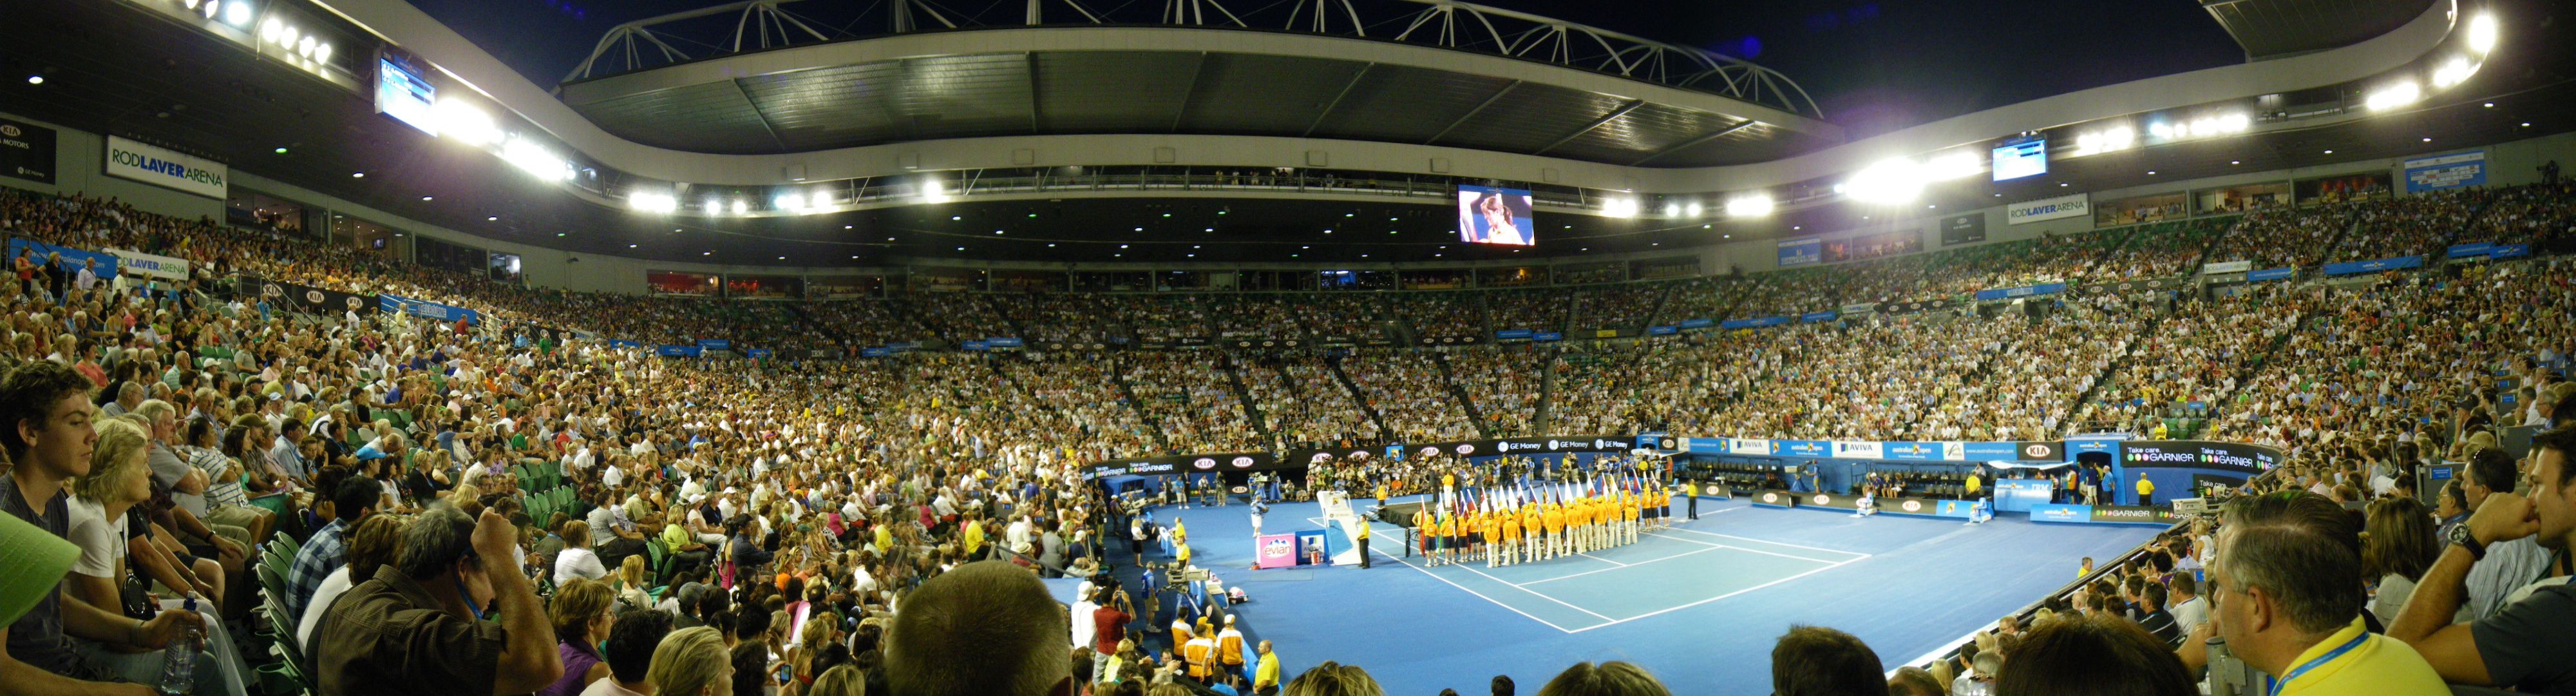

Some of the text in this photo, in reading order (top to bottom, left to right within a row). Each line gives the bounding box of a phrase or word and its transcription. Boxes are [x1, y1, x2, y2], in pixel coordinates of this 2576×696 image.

[3, 126, 18, 135] KIA
[3, 139, 30, 150] MOTORS
[309, 292, 322, 302] KIA
[1520, 442, 1542, 450] Money
[1613, 441, 1628, 450] Money
[2149, 453, 2195, 463] GARNIER
[2219, 455, 2253, 468] GARNIER
[1104, 468, 1126, 476] GARNIER
[1142, 464, 1173, 472] GARNIER
[1264, 545, 1291, 555] evian
